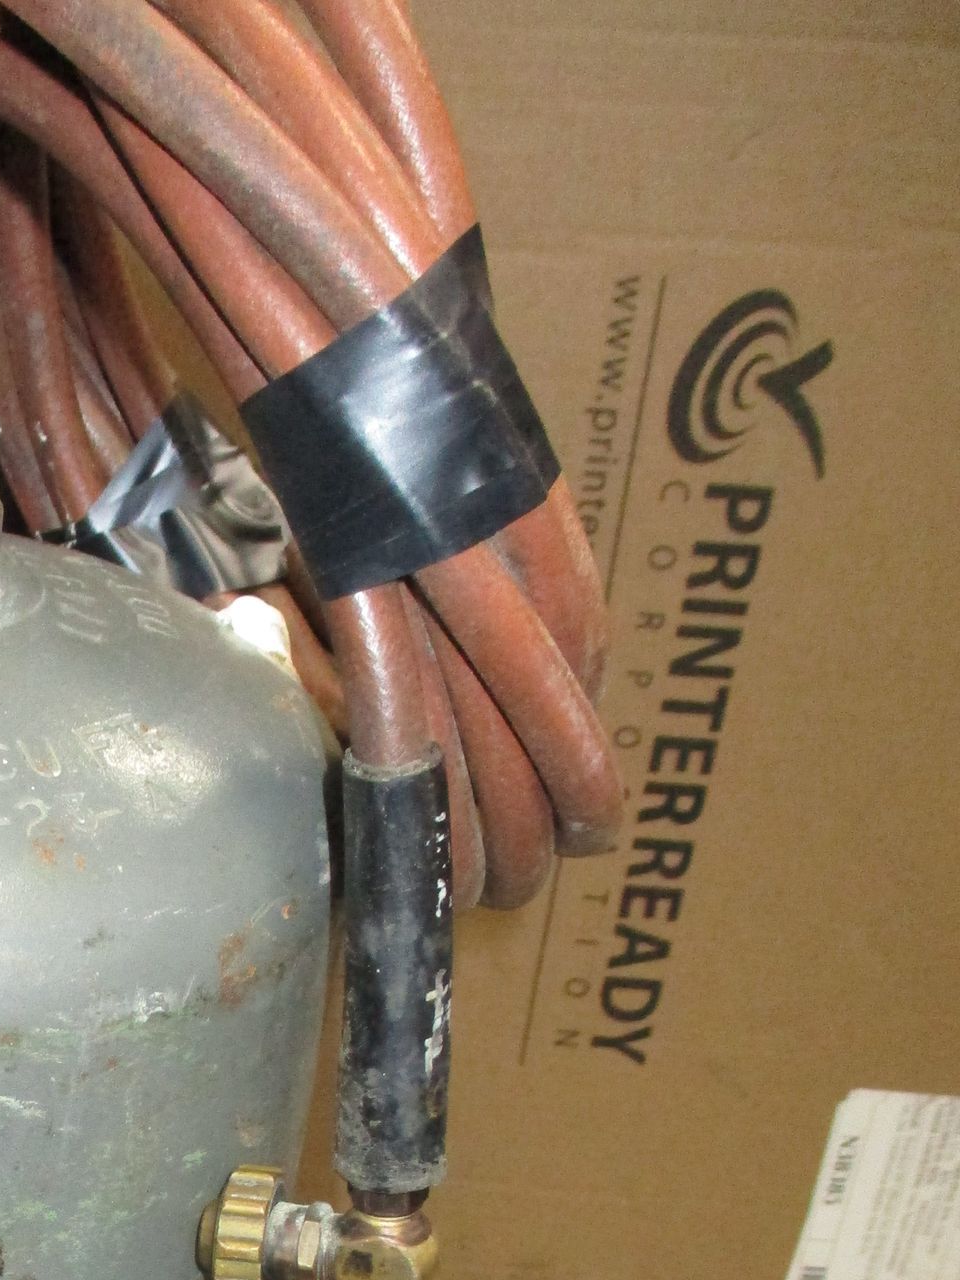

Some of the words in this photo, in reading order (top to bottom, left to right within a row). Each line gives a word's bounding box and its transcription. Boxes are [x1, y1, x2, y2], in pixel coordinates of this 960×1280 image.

[575, 273, 640, 550] www.printe
[553, 478, 691, 1051] CORPOTION
[590, 482, 776, 1067] PRINTERREADY
